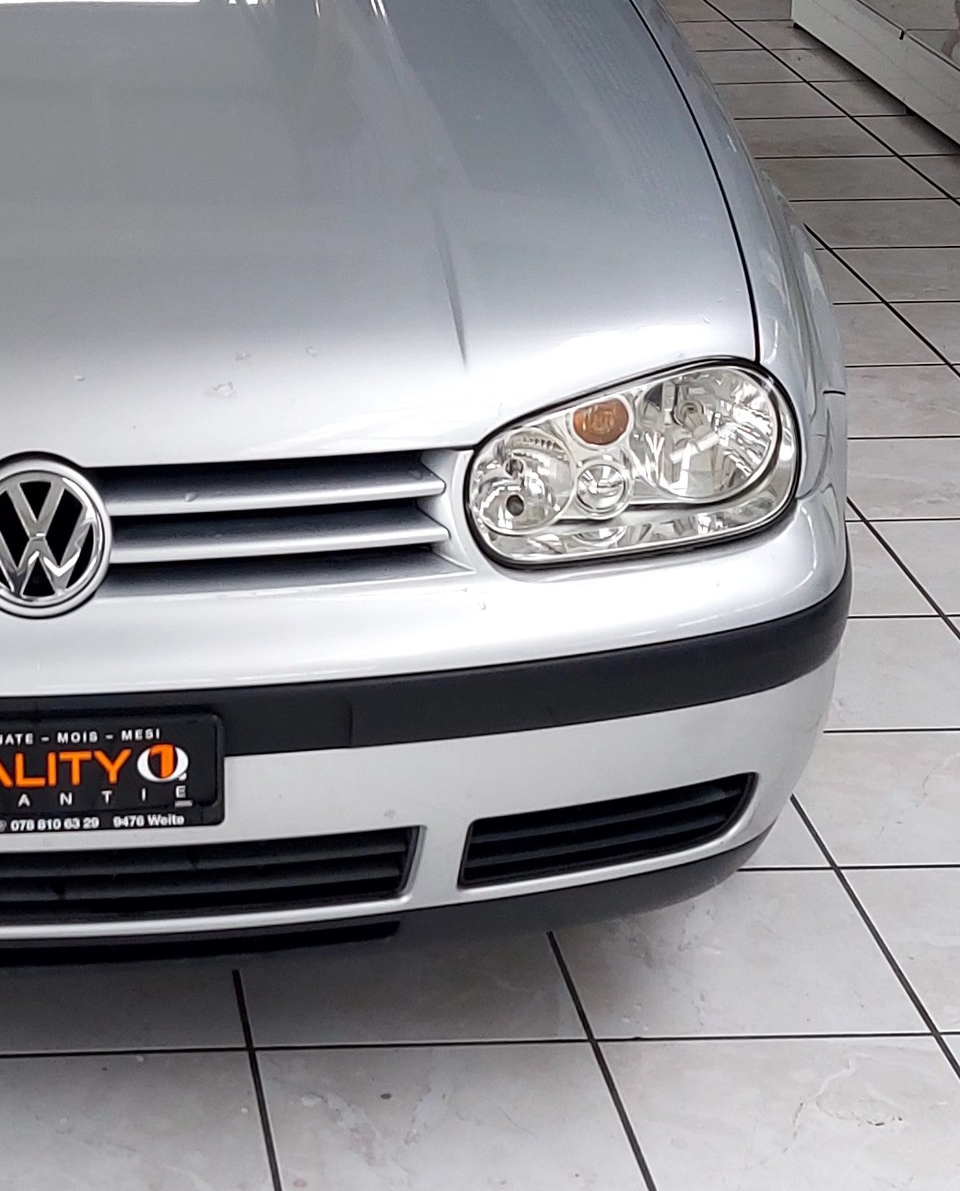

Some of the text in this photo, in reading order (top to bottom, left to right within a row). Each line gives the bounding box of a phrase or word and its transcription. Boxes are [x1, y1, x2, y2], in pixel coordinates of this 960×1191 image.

[56, 731, 98, 744] MOIS
[121, 728, 161, 741] MESI
[10, 819, 35, 832] 078
